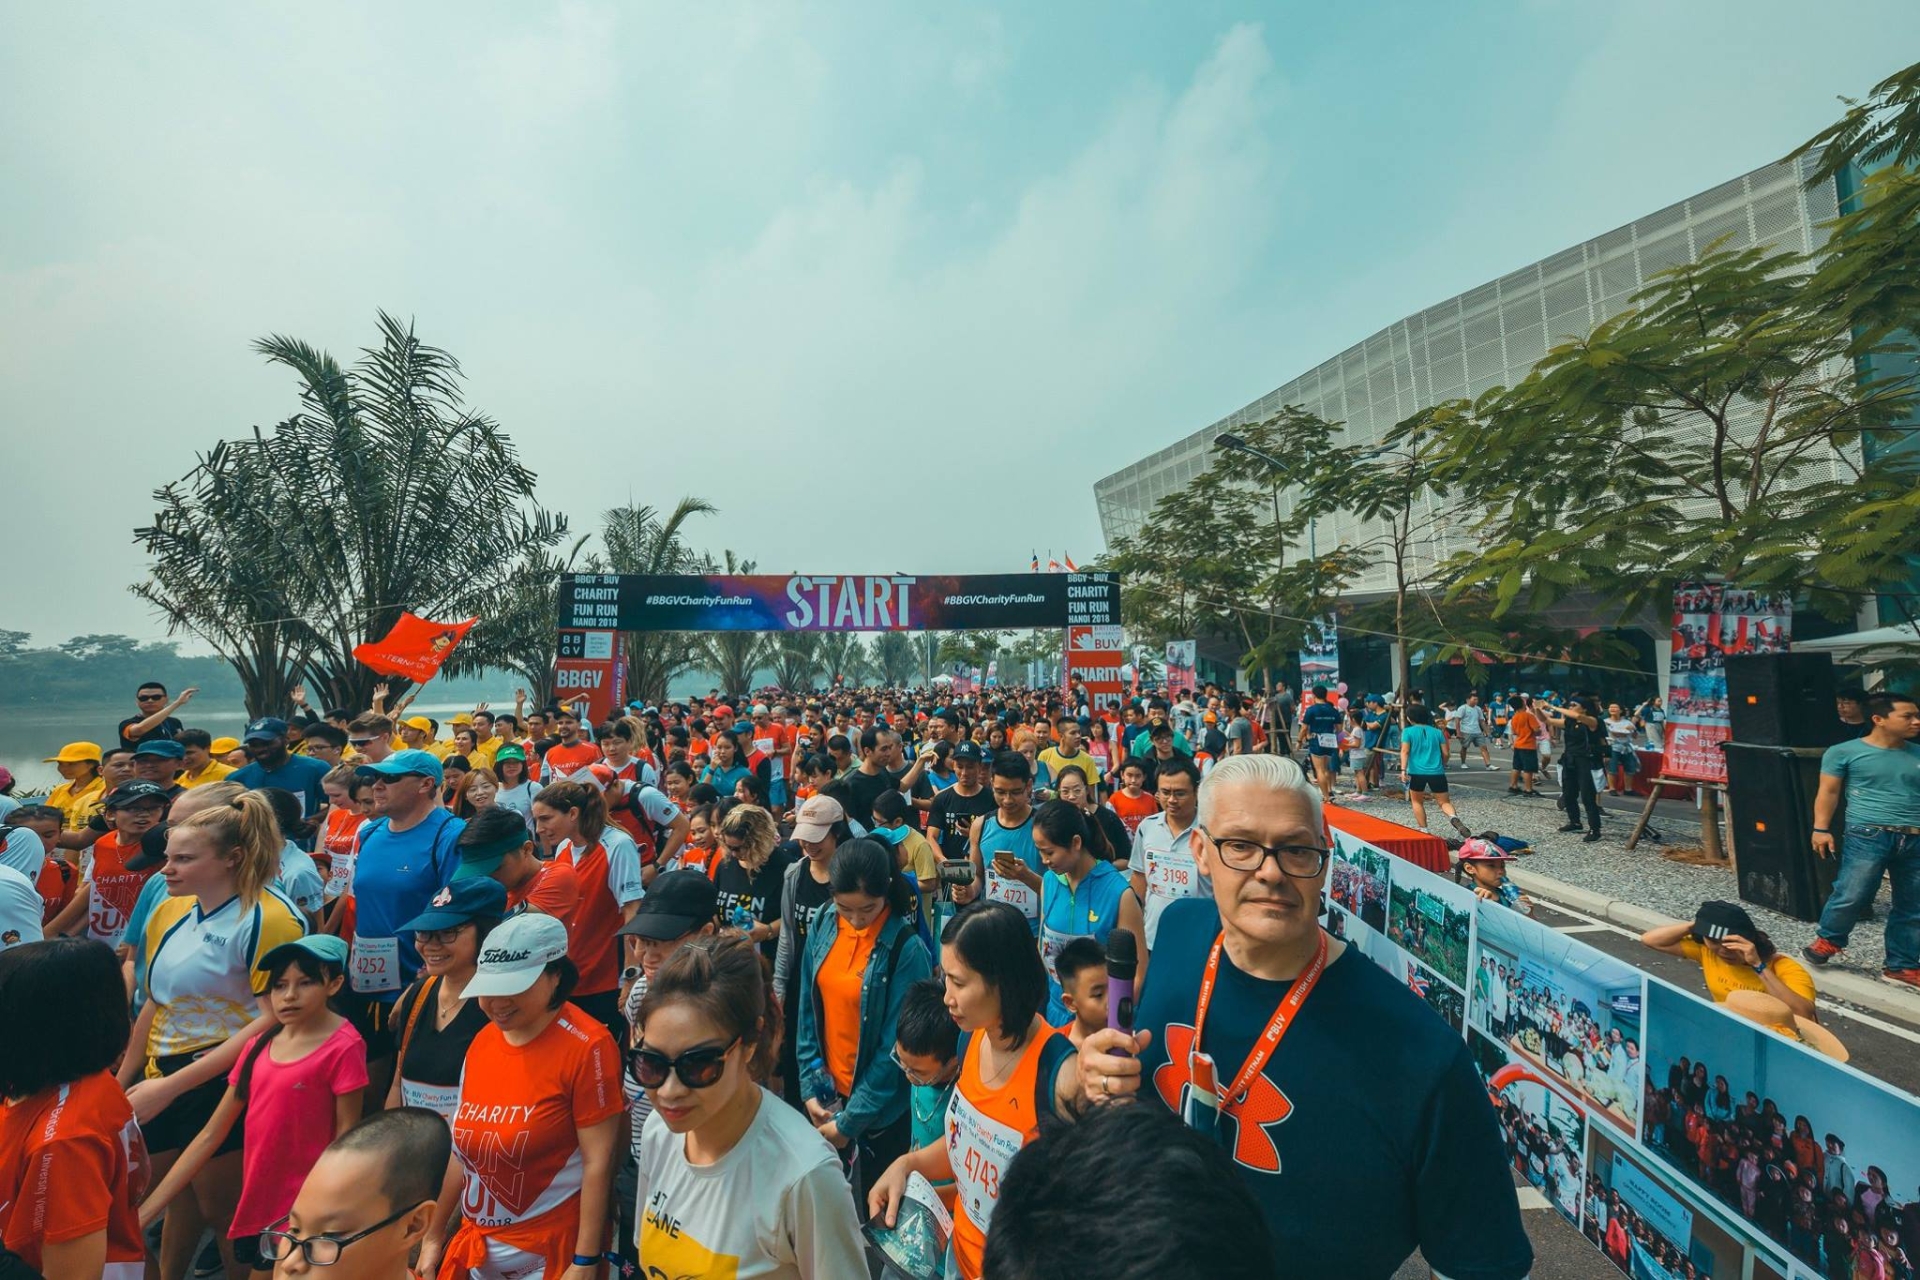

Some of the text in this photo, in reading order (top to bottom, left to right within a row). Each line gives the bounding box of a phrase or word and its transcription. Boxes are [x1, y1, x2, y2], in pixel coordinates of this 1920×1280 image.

[575, 575, 597, 585] BBGV
[603, 575, 620, 585] BUV
[1068, 573, 1109, 583] BBGV BUV
[574, 588, 620, 601] CHARITY
[1068, 586, 1109, 598] CHARITY
[646, 595, 752, 608] #BBGVCharityFunRun
[786, 577, 916, 629] START
[944, 594, 1045, 607] #BBGVCharityFunRun
[1069, 602, 1109, 613] FUN RUN
[573, 604, 619, 617] FUN RUN
[572, 618, 618, 628] HANOI 2018
[1068, 614, 1110, 624] HANOI 2018
[1095, 639, 1120, 649] BUV
[557, 669, 603, 689] BBGV
[1071, 666, 1122, 682] CHARITY
[1094, 692, 1122, 712] FUN
[97, 873, 149, 884] CHARITY
[1163, 868, 1188, 885] 3198
[1004, 889, 1027, 904] 4721
[480, 948, 532, 964] Titleist
[356, 957, 387, 974] 4252
[1290, 980, 1308, 1006] BRITISH
[571, 1026, 591, 1044] British
[1242, 1051, 1265, 1082] VIETNAM
[422, 1092, 439, 1103] Charity
[440, 1094, 452, 1102] Fun
[459, 1102, 537, 1124] CHARITY
[44, 1106, 64, 1143] British
[976, 1122, 993, 1142] Charity
[993, 1133, 1006, 1148] Fun
[1005, 1140, 1018, 1154] Run
[455, 1127, 530, 1174] FUN
[34, 1153, 54, 1195] University
[964, 1146, 999, 1201] 4743
[463, 1172, 526, 1218] UN
